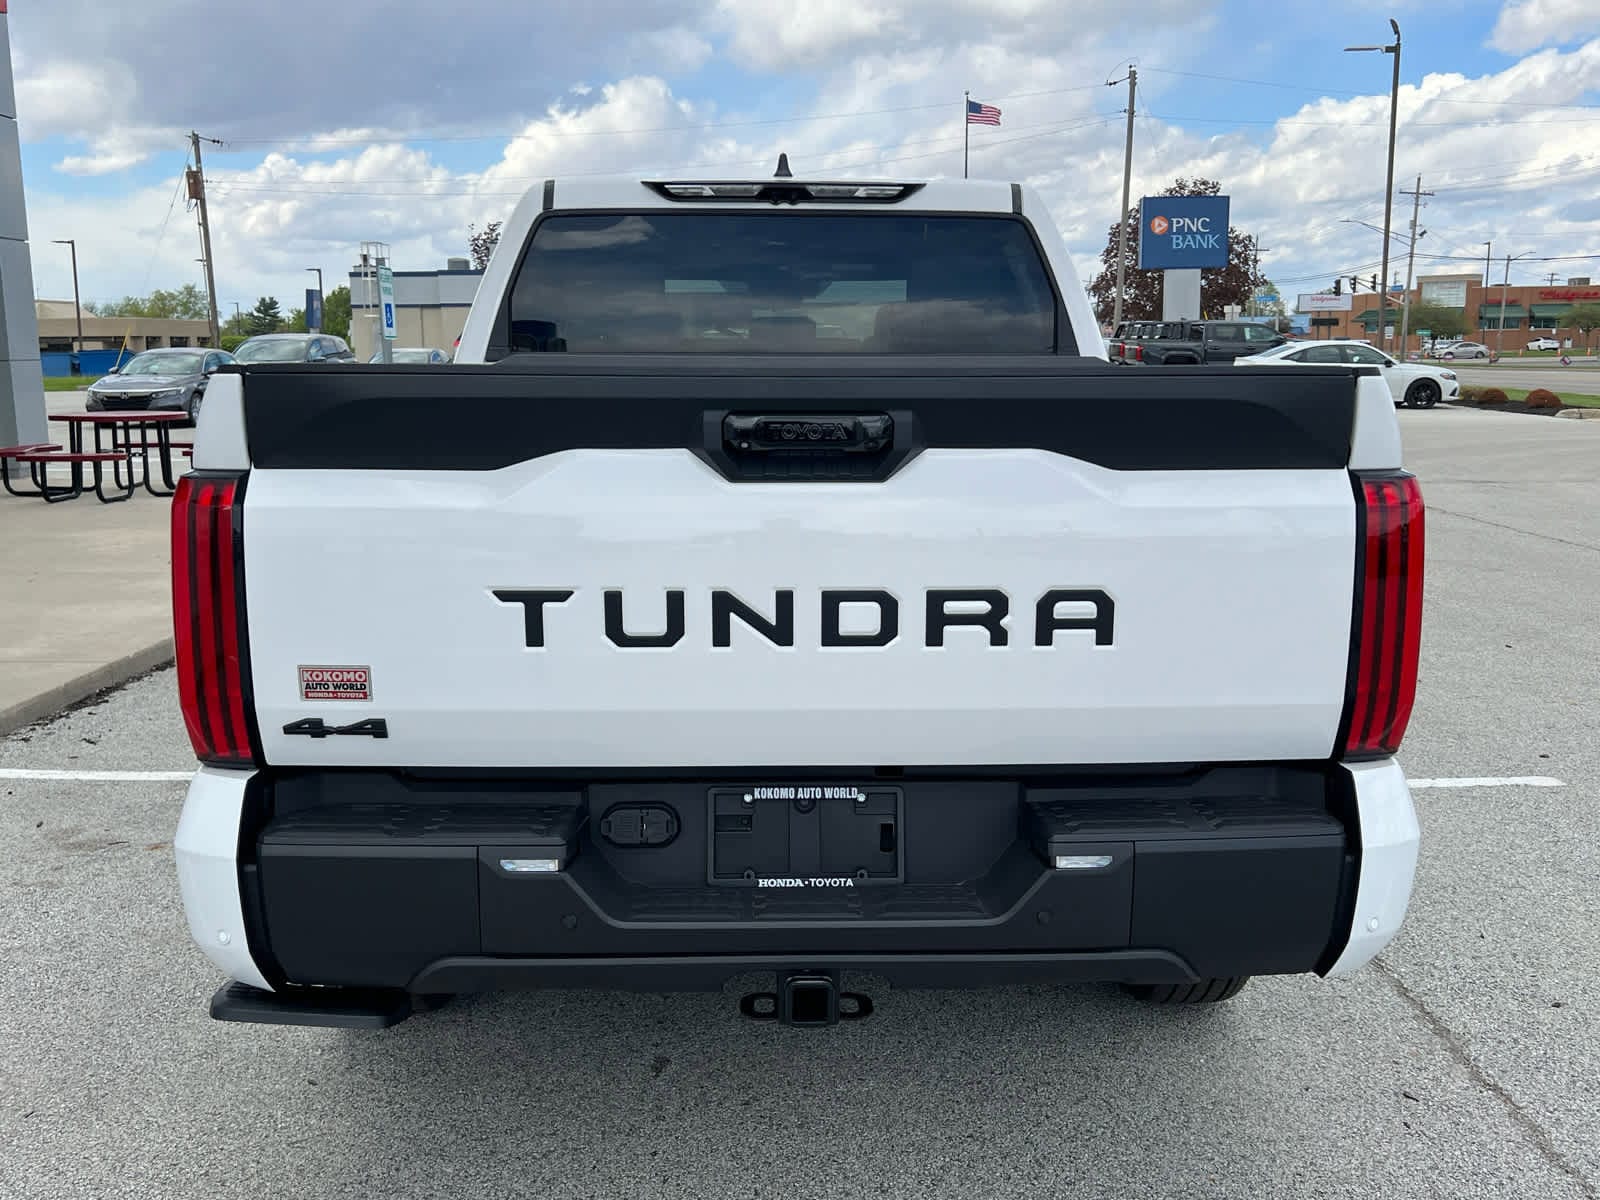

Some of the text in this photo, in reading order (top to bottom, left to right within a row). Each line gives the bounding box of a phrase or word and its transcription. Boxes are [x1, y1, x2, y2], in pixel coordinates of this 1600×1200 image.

[1171, 217, 1210, 233] PNC
[1171, 234, 1220, 249] BANK
[768, 422, 848, 440] TOYOTA
[490, 588, 1115, 648] TUNDRA
[303, 671, 366, 682] KOKOMO
[754, 787, 858, 799] KOKOMO AUTO WORLD
[758, 878, 854, 887] HONDA TOYOTA
